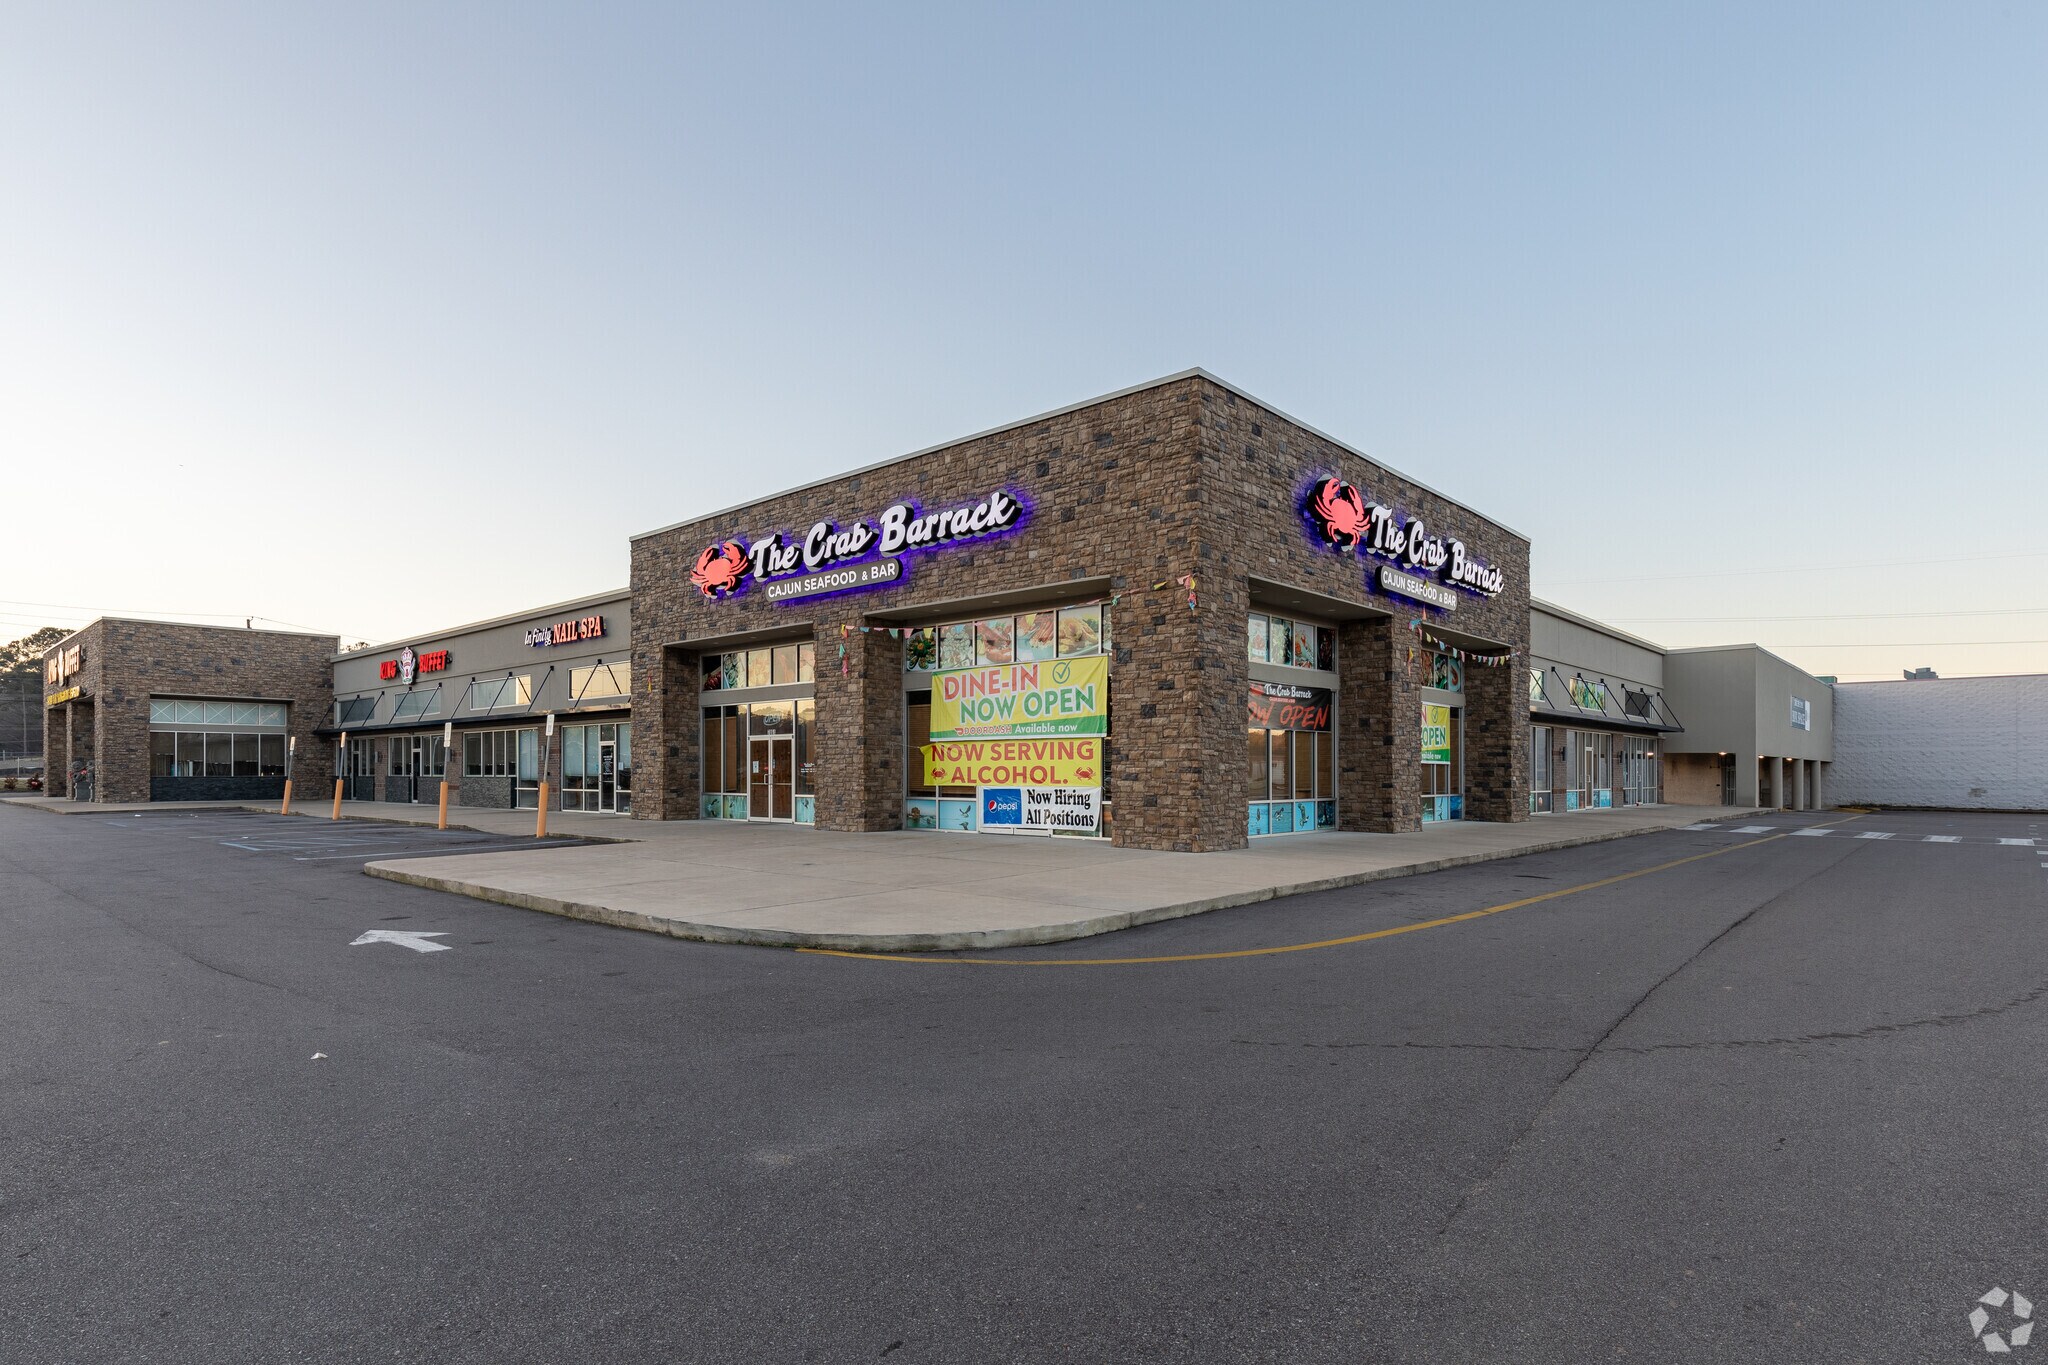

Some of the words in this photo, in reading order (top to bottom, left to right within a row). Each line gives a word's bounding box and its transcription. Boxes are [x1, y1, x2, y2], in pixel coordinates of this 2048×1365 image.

[748, 533, 799, 578] The
[803, 522, 872, 567] Crab
[879, 492, 1015, 552] Barrack
[1371, 505, 1407, 554] The
[1409, 520, 1448, 566] Crab
[1452, 541, 1504, 593] Barrack
[768, 581, 802, 598] CAJUN
[804, 570, 857, 592] SEAFOOD
[862, 570, 868, 581] &
[871, 562, 896, 579] BAR
[1382, 570, 1406, 590] CAJUN
[1406, 581, 1438, 601] SEAFOOD
[1443, 592, 1457, 607] BAR
[553, 621, 578, 644] NAIL
[580, 615, 602, 639] SPA
[379, 659, 397, 680] KING
[418, 650, 447, 673] BUFFET
[944, 664, 1039, 700] DINE-IN
[1264, 683, 1276, 695] The
[1277, 684, 1291, 697] Crab
[1291, 685, 1312, 699] Barrack
[960, 694, 1017, 723] NOW
[1024, 685, 1094, 717] OPEN
[1248, 700, 1275, 727] OW
[1280, 704, 1330, 730] OPEN
[963, 724, 1012, 736] DOORDASH
[1015, 722, 1056, 734] Available
[1058, 724, 1078, 732] now
[1422, 726, 1446, 747] OPEN
[931, 743, 985, 762] NOW
[990, 741, 1094, 761] SERVING
[951, 765, 1069, 785] ALCOHOL.
[997, 801, 1018, 812] pepsi
[1027, 789, 1051, 805] Now
[1054, 788, 1091, 810] Hiring
[1026, 809, 1041, 825] All
[1043, 808, 1095, 828] Positions
